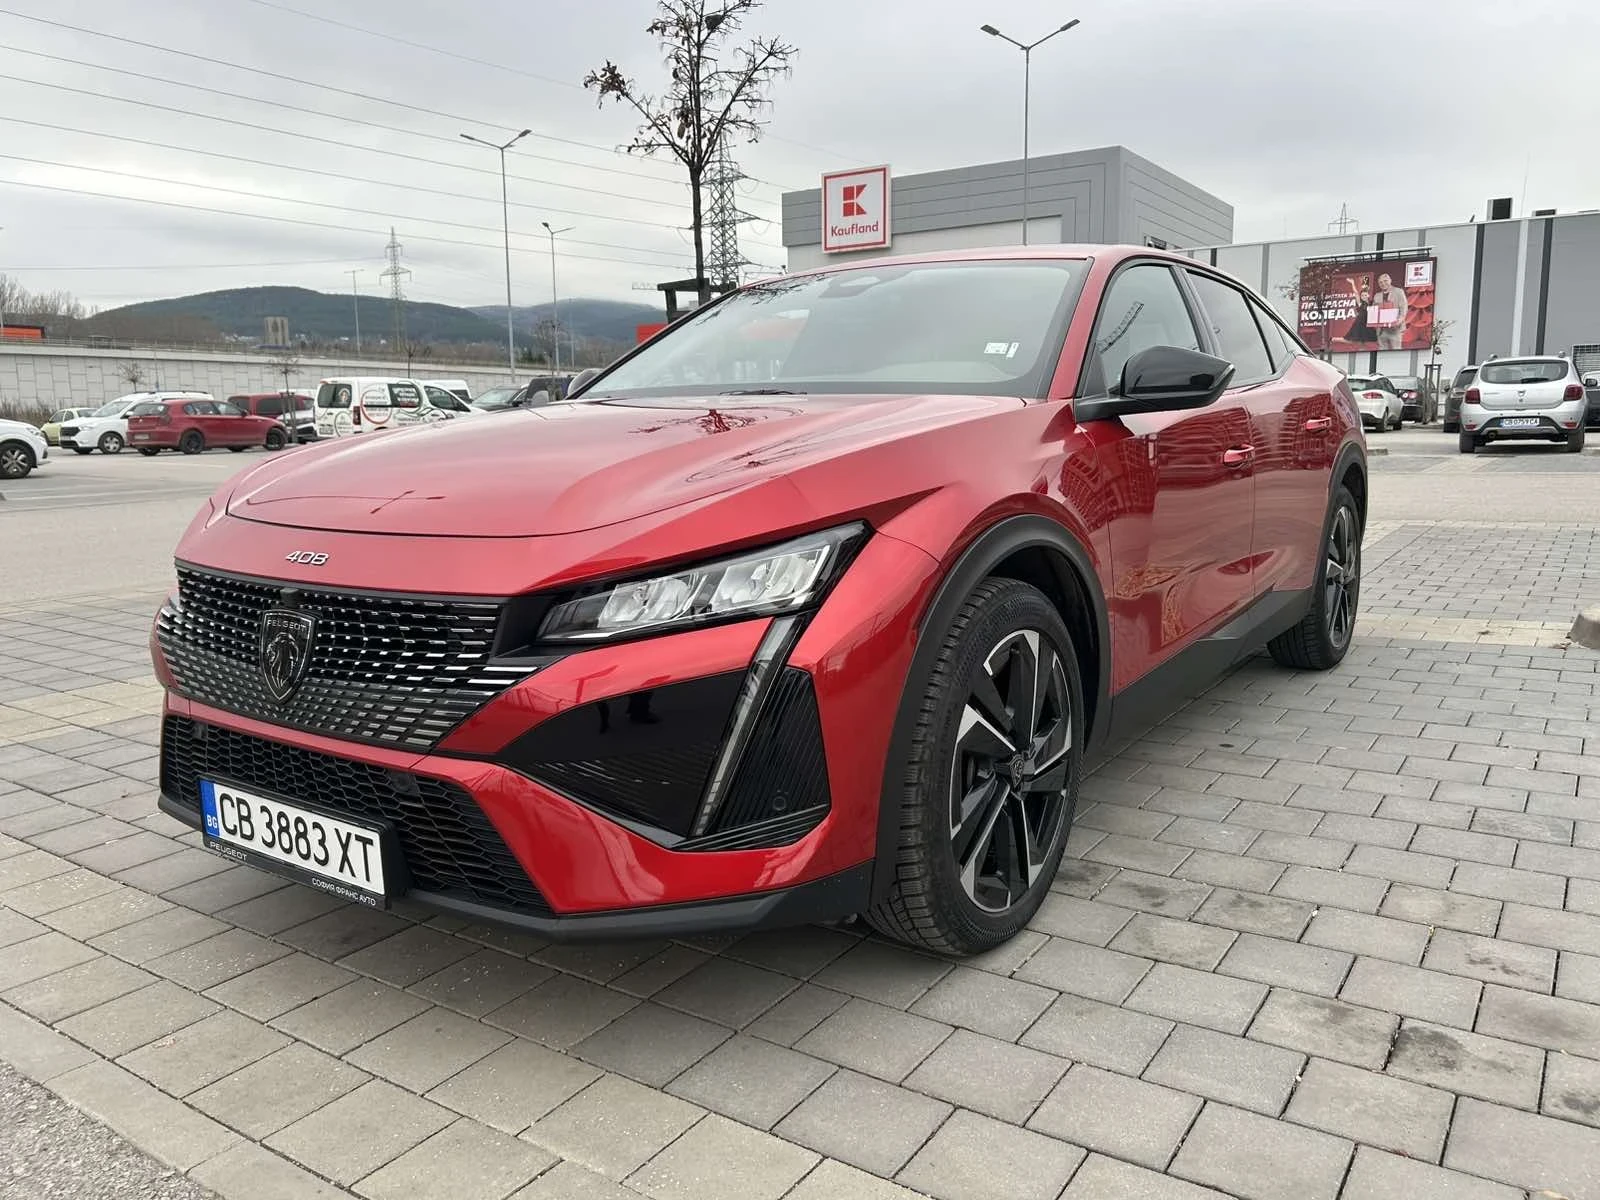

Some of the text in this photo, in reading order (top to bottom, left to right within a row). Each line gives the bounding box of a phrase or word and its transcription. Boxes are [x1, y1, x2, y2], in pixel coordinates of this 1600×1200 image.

[831, 220, 879, 237] Kaufland
[1301, 308, 1357, 321] КОЛЕДА
[285, 550, 329, 566] 408
[266, 619, 307, 631] PEUGEOT
[207, 814, 218, 829] BG
[219, 792, 374, 882] CB 3883 XT
[210, 841, 247, 861] PEUGEOT
[312, 878, 336, 892] СОФИЯ
[335, 886, 359, 900] ФРАНС
